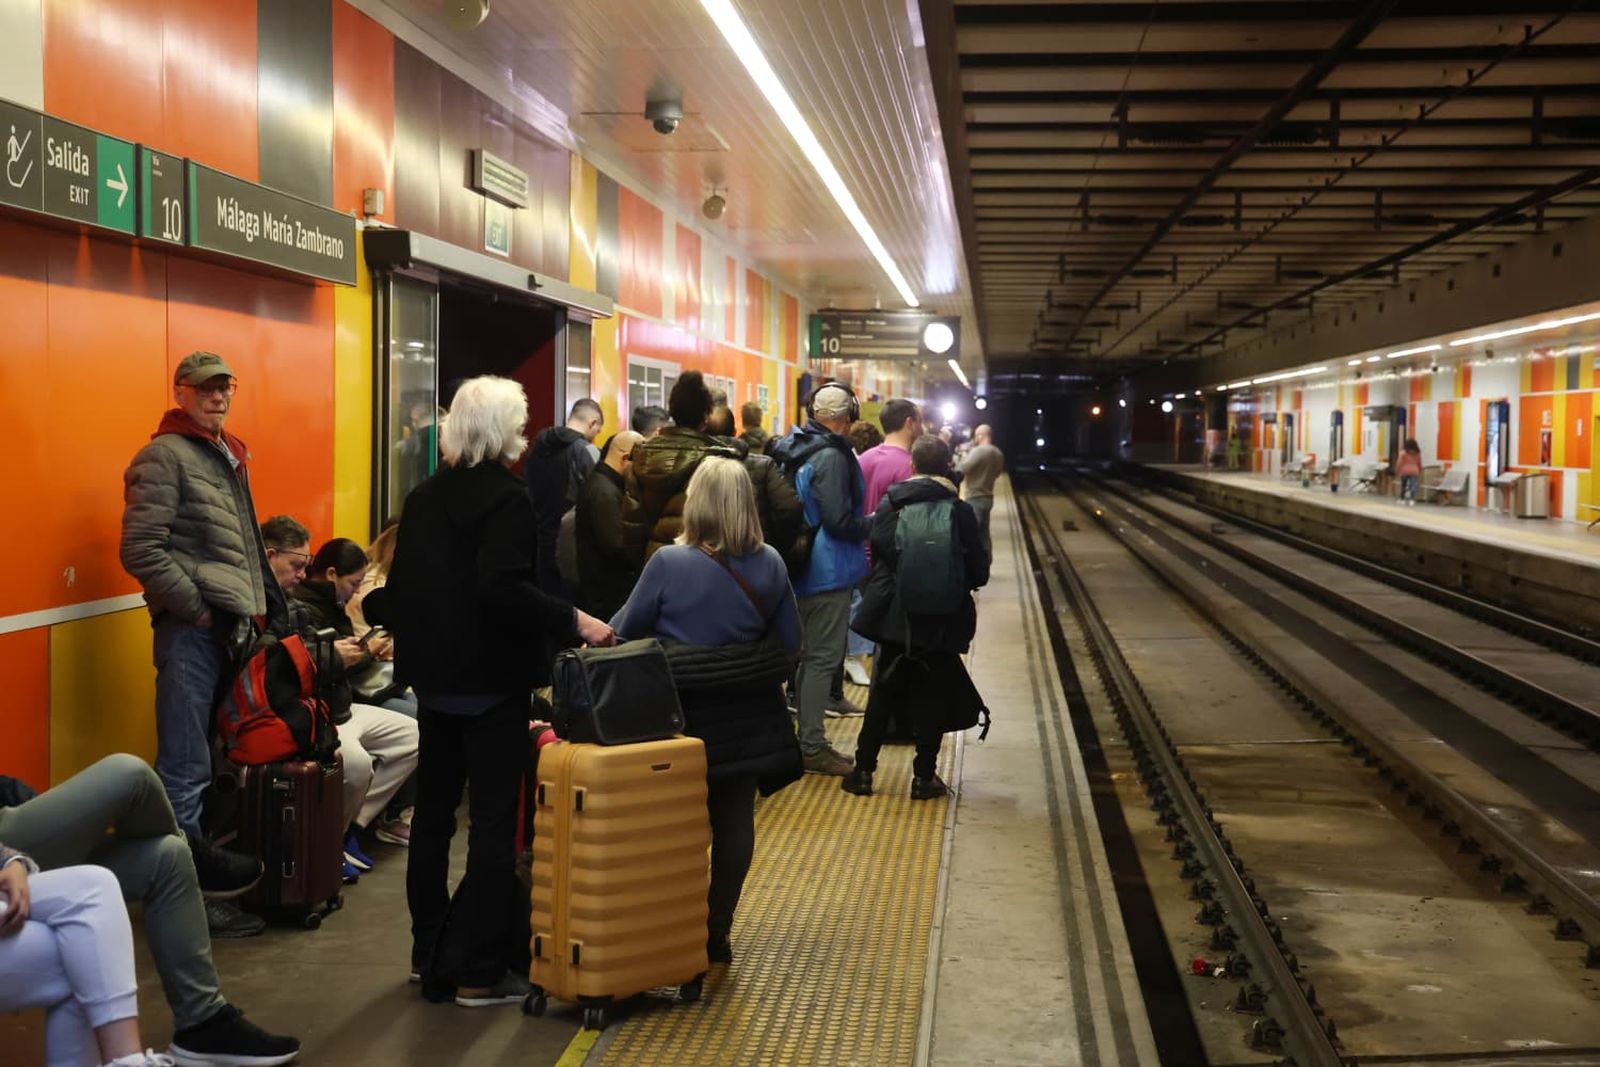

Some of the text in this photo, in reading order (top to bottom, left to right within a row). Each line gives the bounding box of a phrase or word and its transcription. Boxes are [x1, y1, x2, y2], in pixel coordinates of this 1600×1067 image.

[47, 137, 89, 177] Salida
[69, 184, 89, 206] EXIT
[162, 197, 182, 241] 10
[217, 195, 344, 259] Málaga María Zambrano
[820, 337, 840, 353] 10
